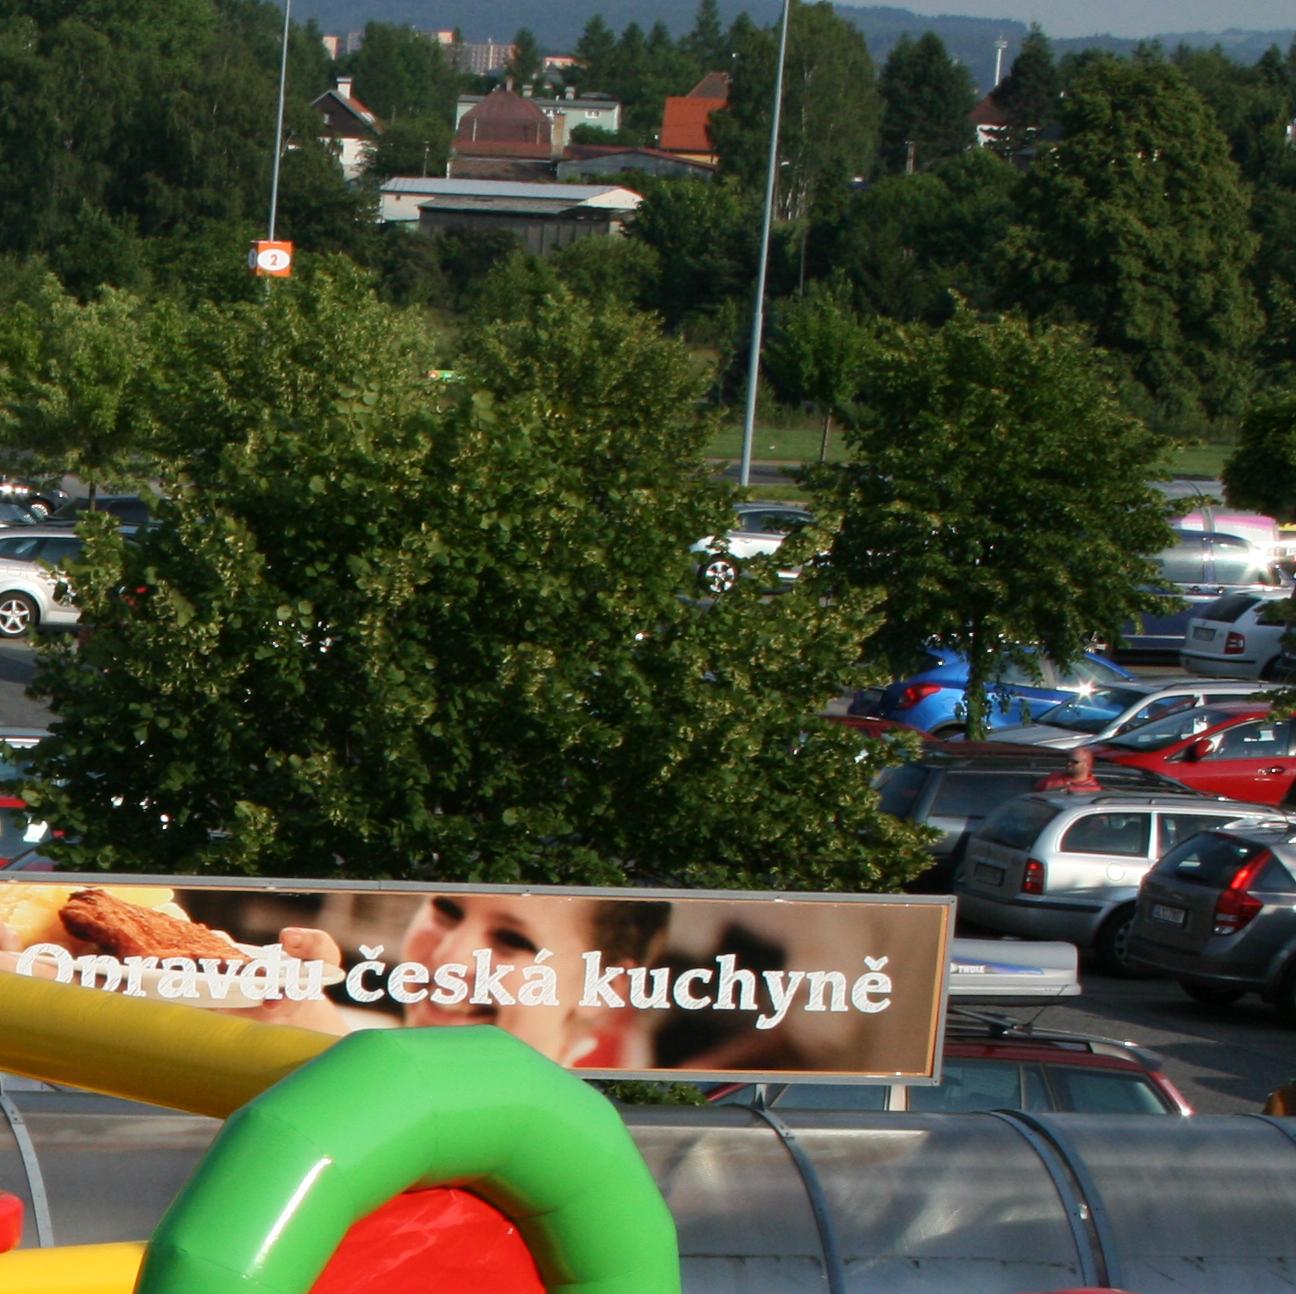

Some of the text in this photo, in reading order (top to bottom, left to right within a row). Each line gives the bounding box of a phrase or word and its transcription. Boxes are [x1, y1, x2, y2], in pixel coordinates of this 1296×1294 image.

[270, 254, 278, 266] 2
[345, 944, 559, 1007] česká
[578, 949, 893, 1031] kuchyně
